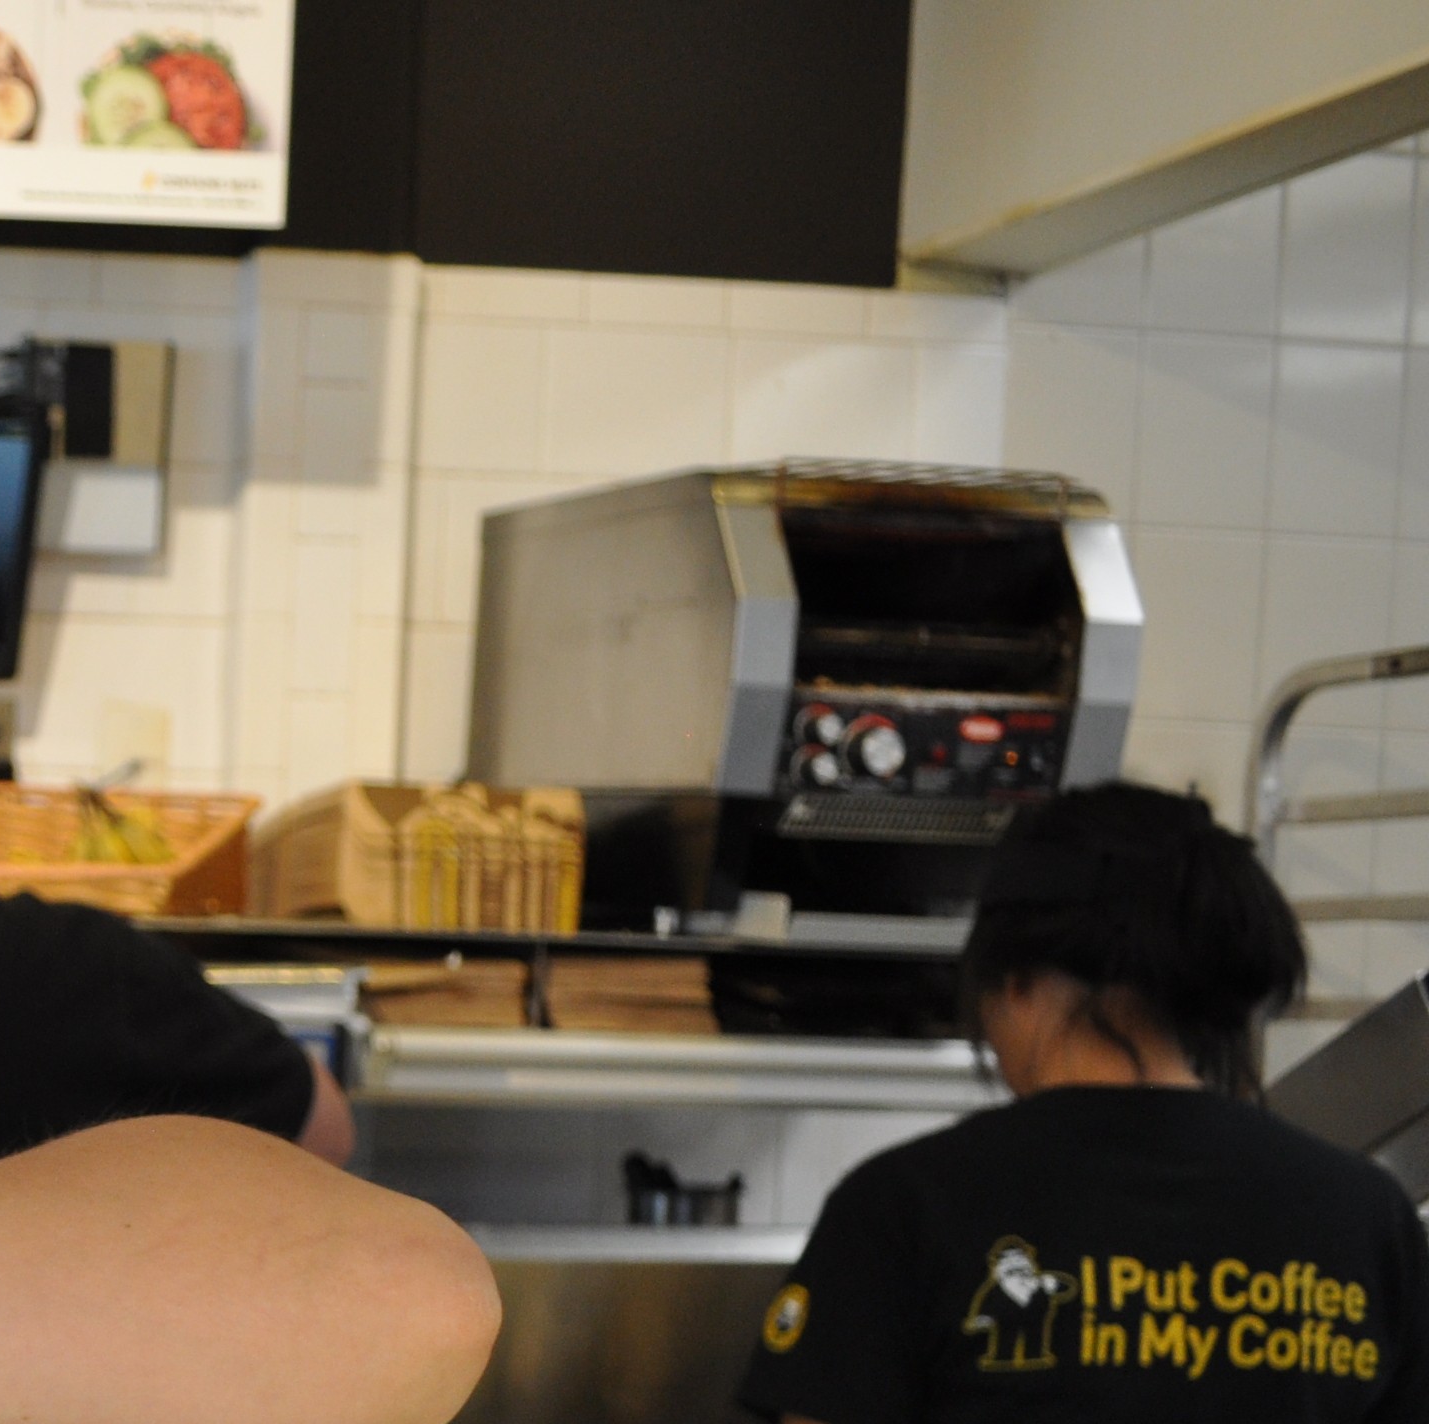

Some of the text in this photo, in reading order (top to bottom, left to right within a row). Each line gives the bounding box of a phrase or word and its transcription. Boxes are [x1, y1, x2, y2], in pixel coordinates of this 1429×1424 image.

[1079, 1255, 1369, 1324] I Put Coffee
[1079, 1312, 1380, 1382] in My Coffee
